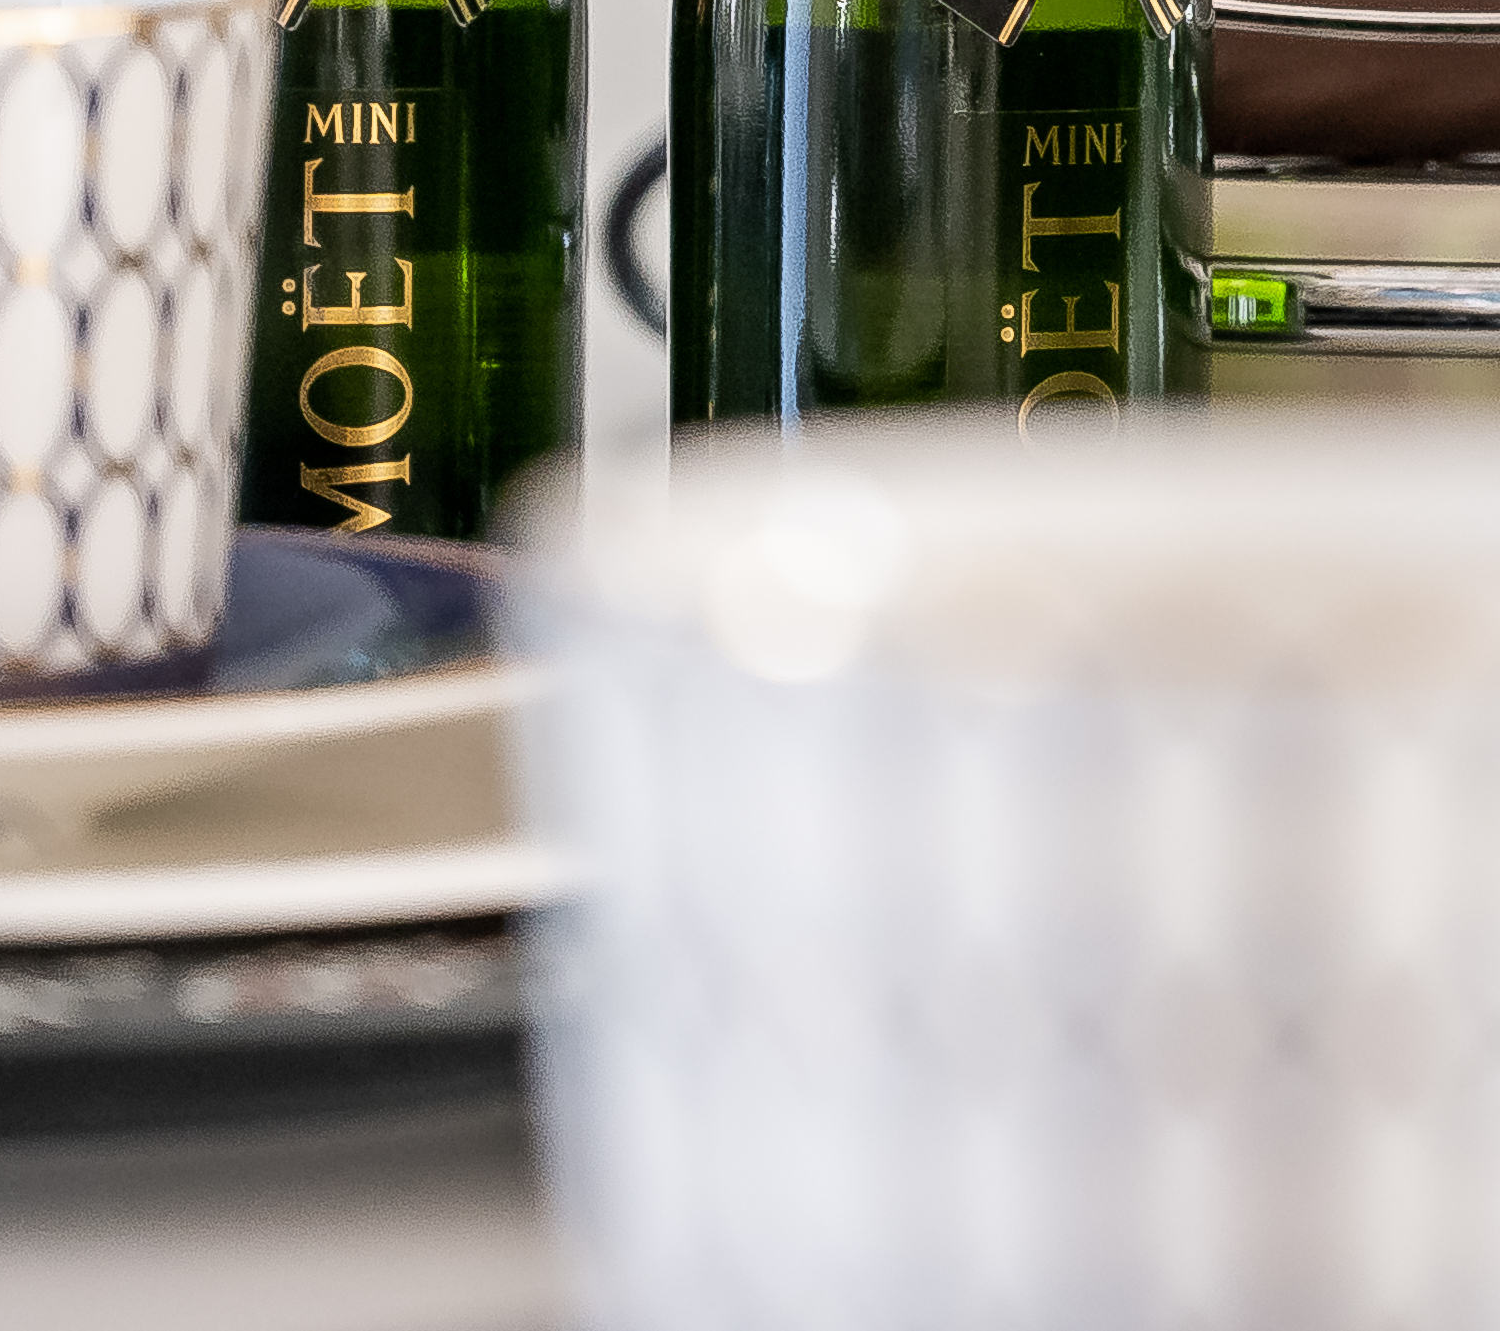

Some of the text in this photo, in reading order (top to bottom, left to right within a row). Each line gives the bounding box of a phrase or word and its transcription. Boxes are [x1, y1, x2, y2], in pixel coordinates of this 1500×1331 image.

[304, 102, 416, 144] MINI
[1022, 121, 1124, 167] MINI
[1000, 180, 1122, 446] OËT
